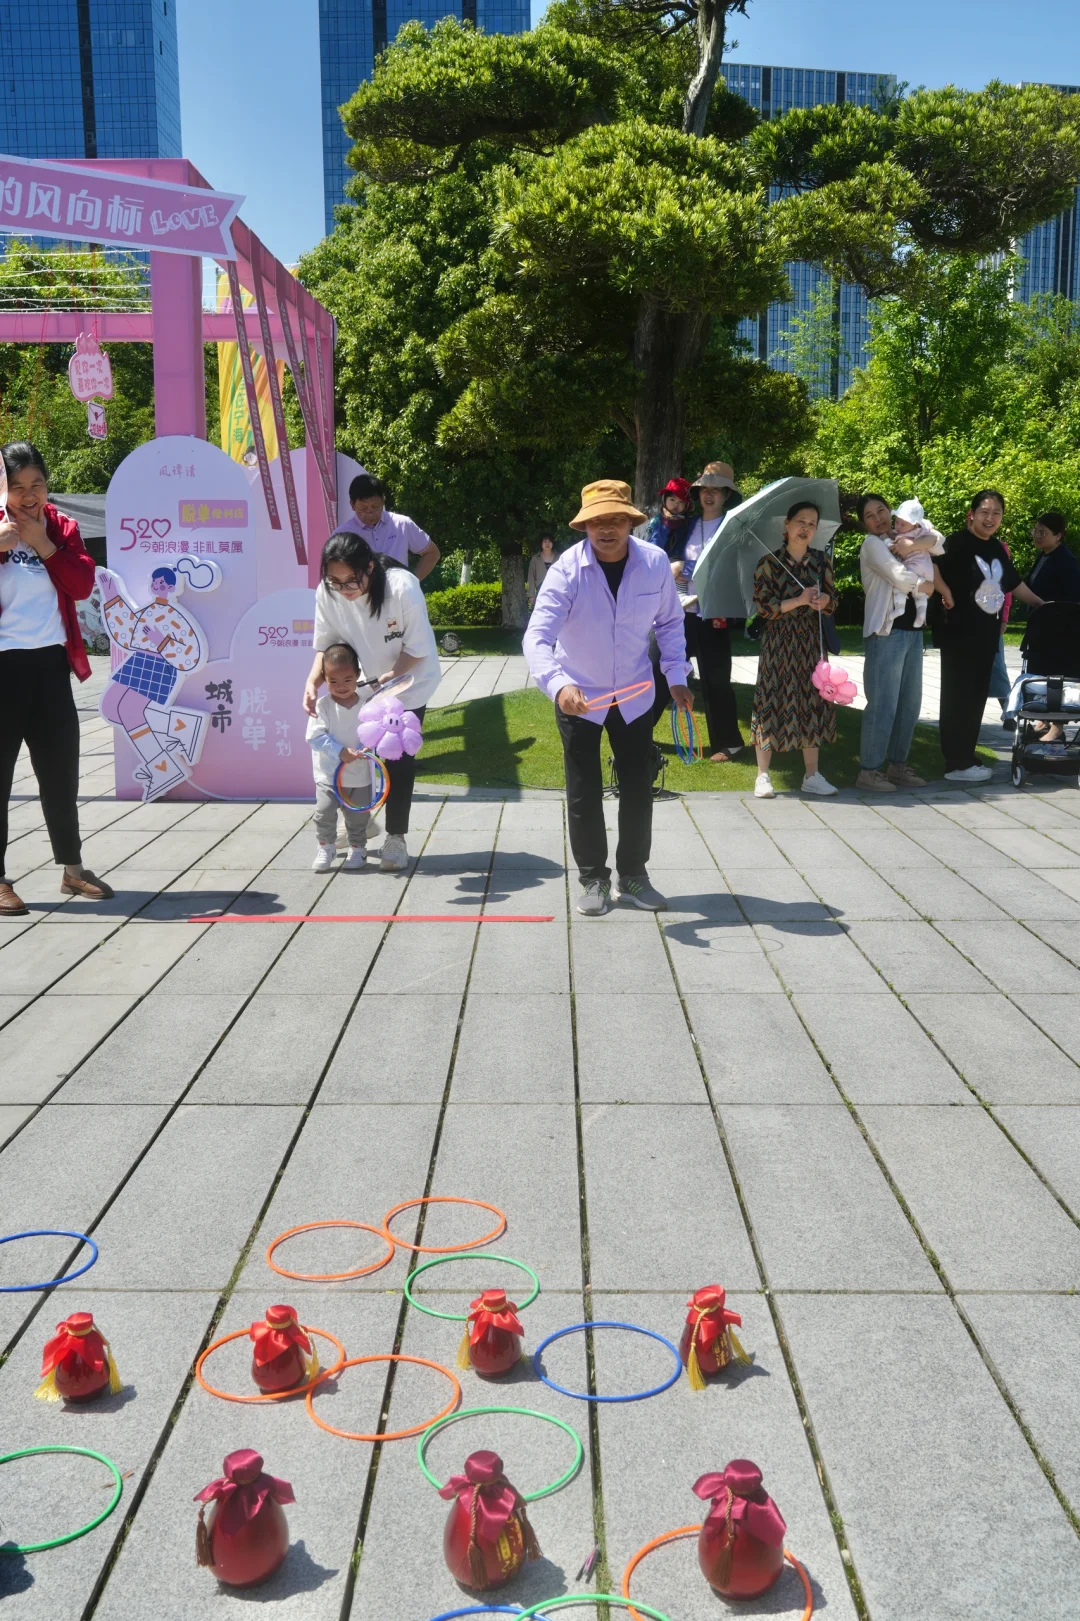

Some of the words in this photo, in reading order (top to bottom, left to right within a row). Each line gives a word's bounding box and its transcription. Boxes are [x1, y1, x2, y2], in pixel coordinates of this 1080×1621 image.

[0, 176, 145, 236] 的风向标
[150, 204, 219, 236] LOVE
[140, 540, 189, 553] 今朝浪漫
[193, 540, 243, 554] 非礼莫属
[204, 678, 234, 734] 城市
[238, 687, 272, 751] 脱单
[275, 720, 292, 757] 计划
